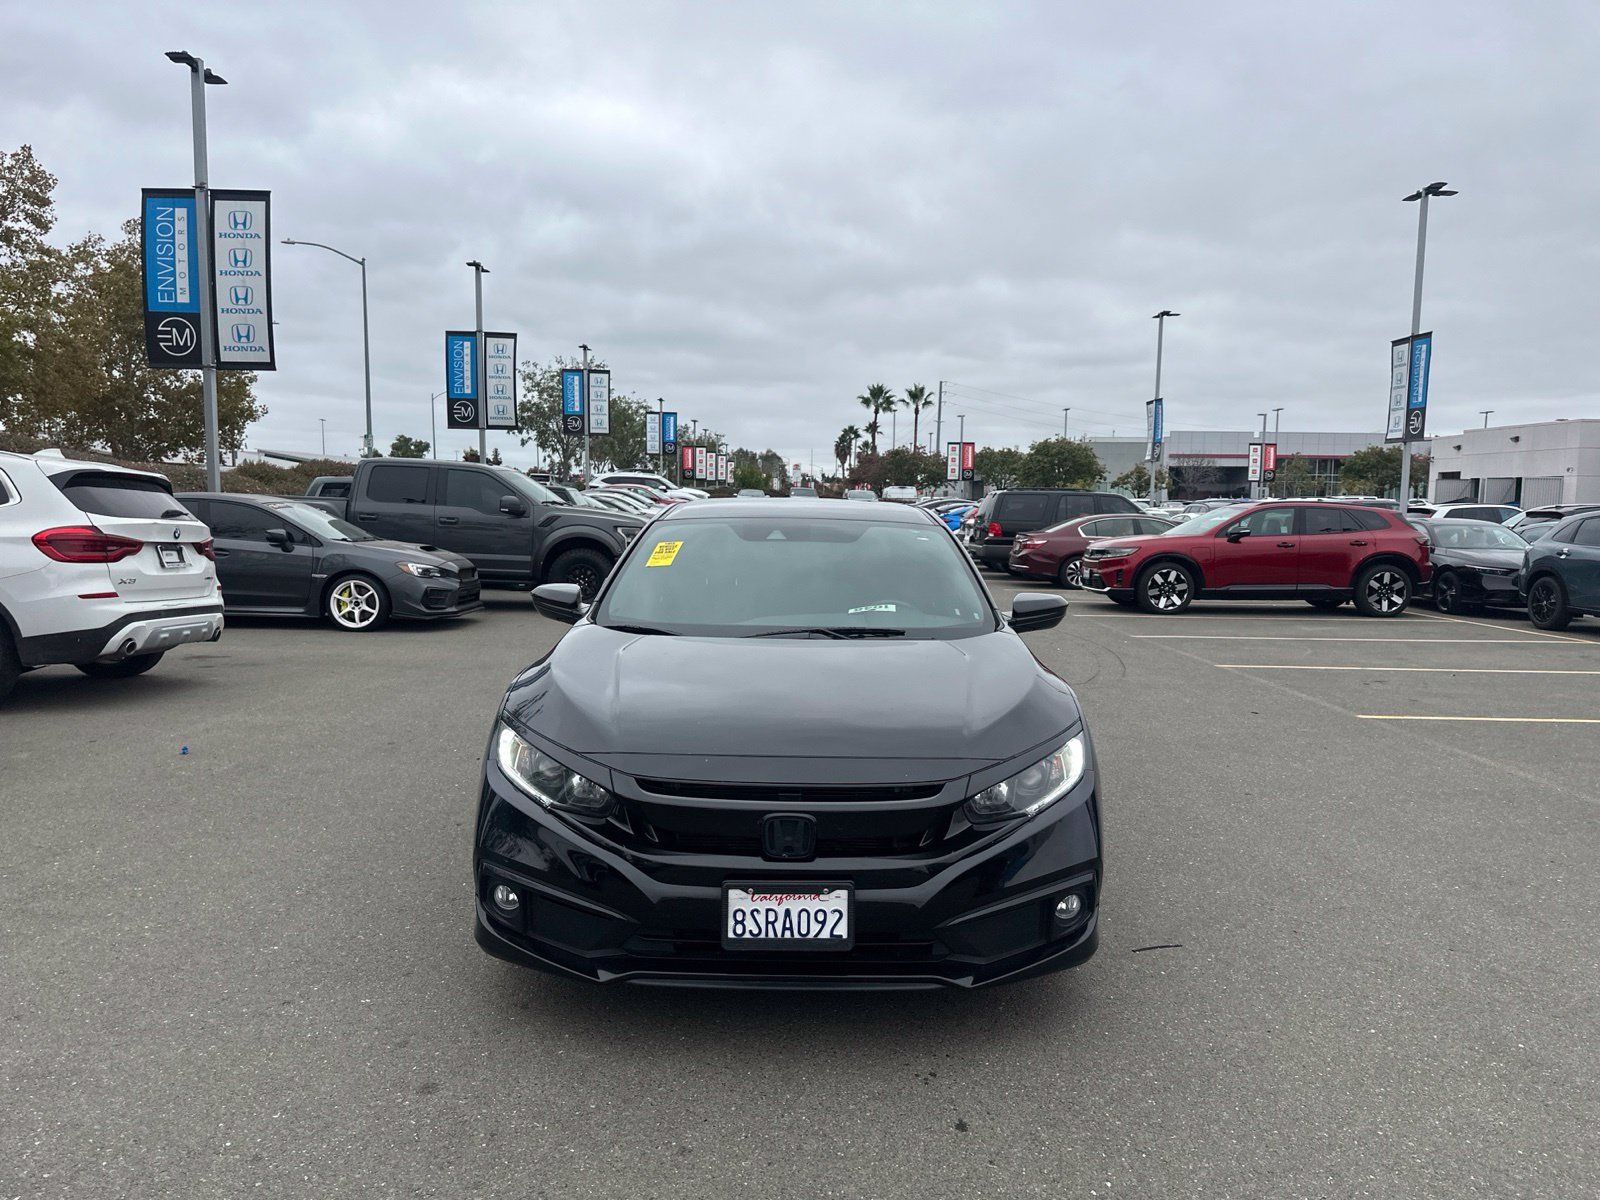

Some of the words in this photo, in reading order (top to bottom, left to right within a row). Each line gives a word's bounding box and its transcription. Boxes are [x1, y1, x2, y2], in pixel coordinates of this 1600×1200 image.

[156, 207, 175, 303] ENVISION
[177, 216, 187, 295] MOTORS
[454, 340, 464, 394] ENVISION
[732, 907, 844, 938] 8SRA092
